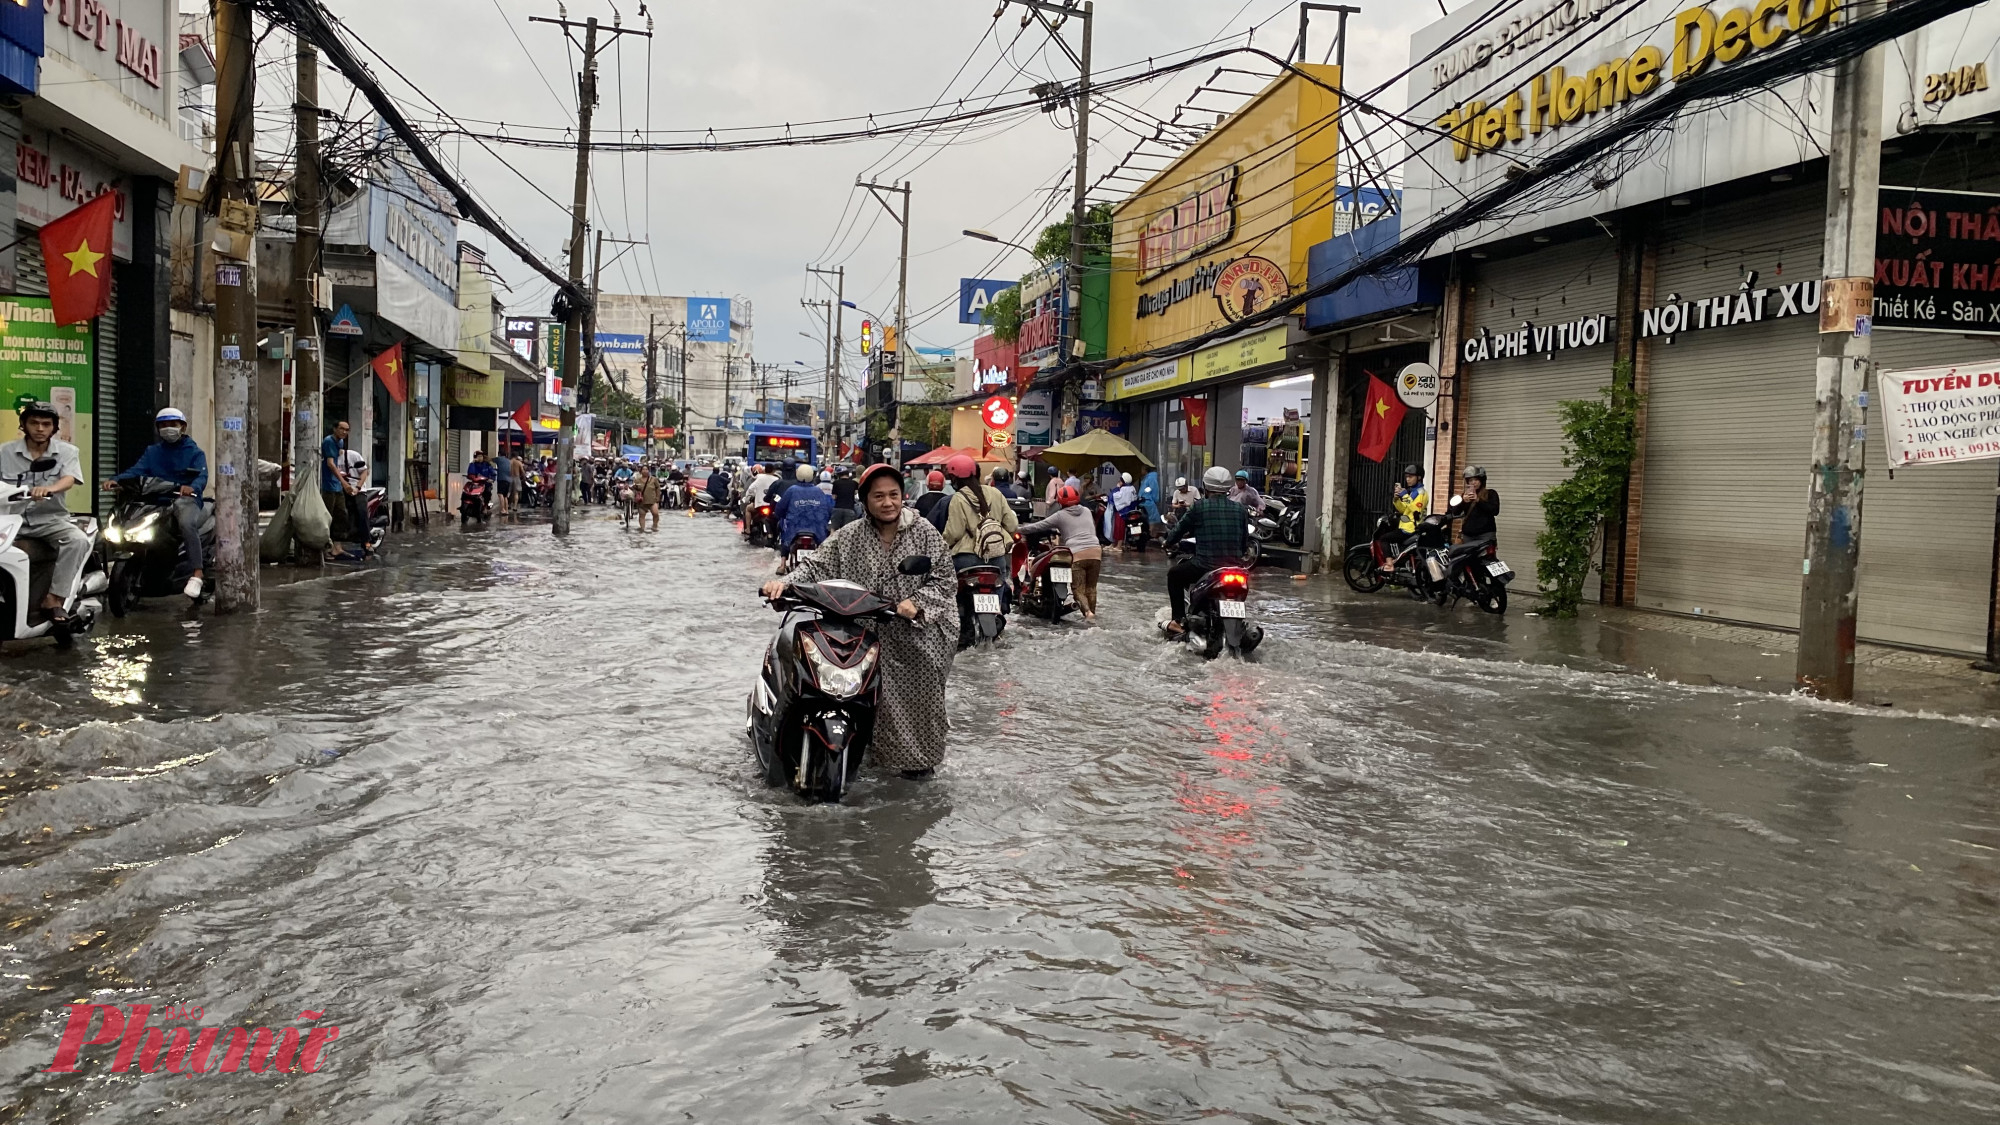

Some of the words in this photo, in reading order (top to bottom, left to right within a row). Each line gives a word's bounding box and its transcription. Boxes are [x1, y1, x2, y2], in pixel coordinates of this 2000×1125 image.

[1430, 38, 1492, 89] TRUNG
[1923, 62, 1988, 104] 230A
[1437, 90, 1523, 161] Viet
[1530, 45, 1661, 134] Home
[1883, 202, 1936, 244] NỘI
[1873, 249, 1944, 288] XUẤT
[1642, 293, 1689, 344] NỘI
[1697, 270, 1768, 329] THẤT
[1914, 295, 1936, 320] Kế
[1952, 300, 1984, 321] Sản
[508, 321, 534, 331] KFC
[691, 320, 725, 328] APOLLO
[1464, 327, 1490, 362] CÀ
[1494, 321, 1530, 359] PHÊ
[1534, 325, 1555, 360] VỊ
[1558, 314, 1606, 350] TƯƠI
[1903, 369, 1972, 394] TUYỂN
[1093, 417, 1120, 430] Tiger
[1914, 416, 1938, 428] LAO
[1918, 431, 1941, 444] HỌC
[1939, 445, 1957, 458] Hệ
